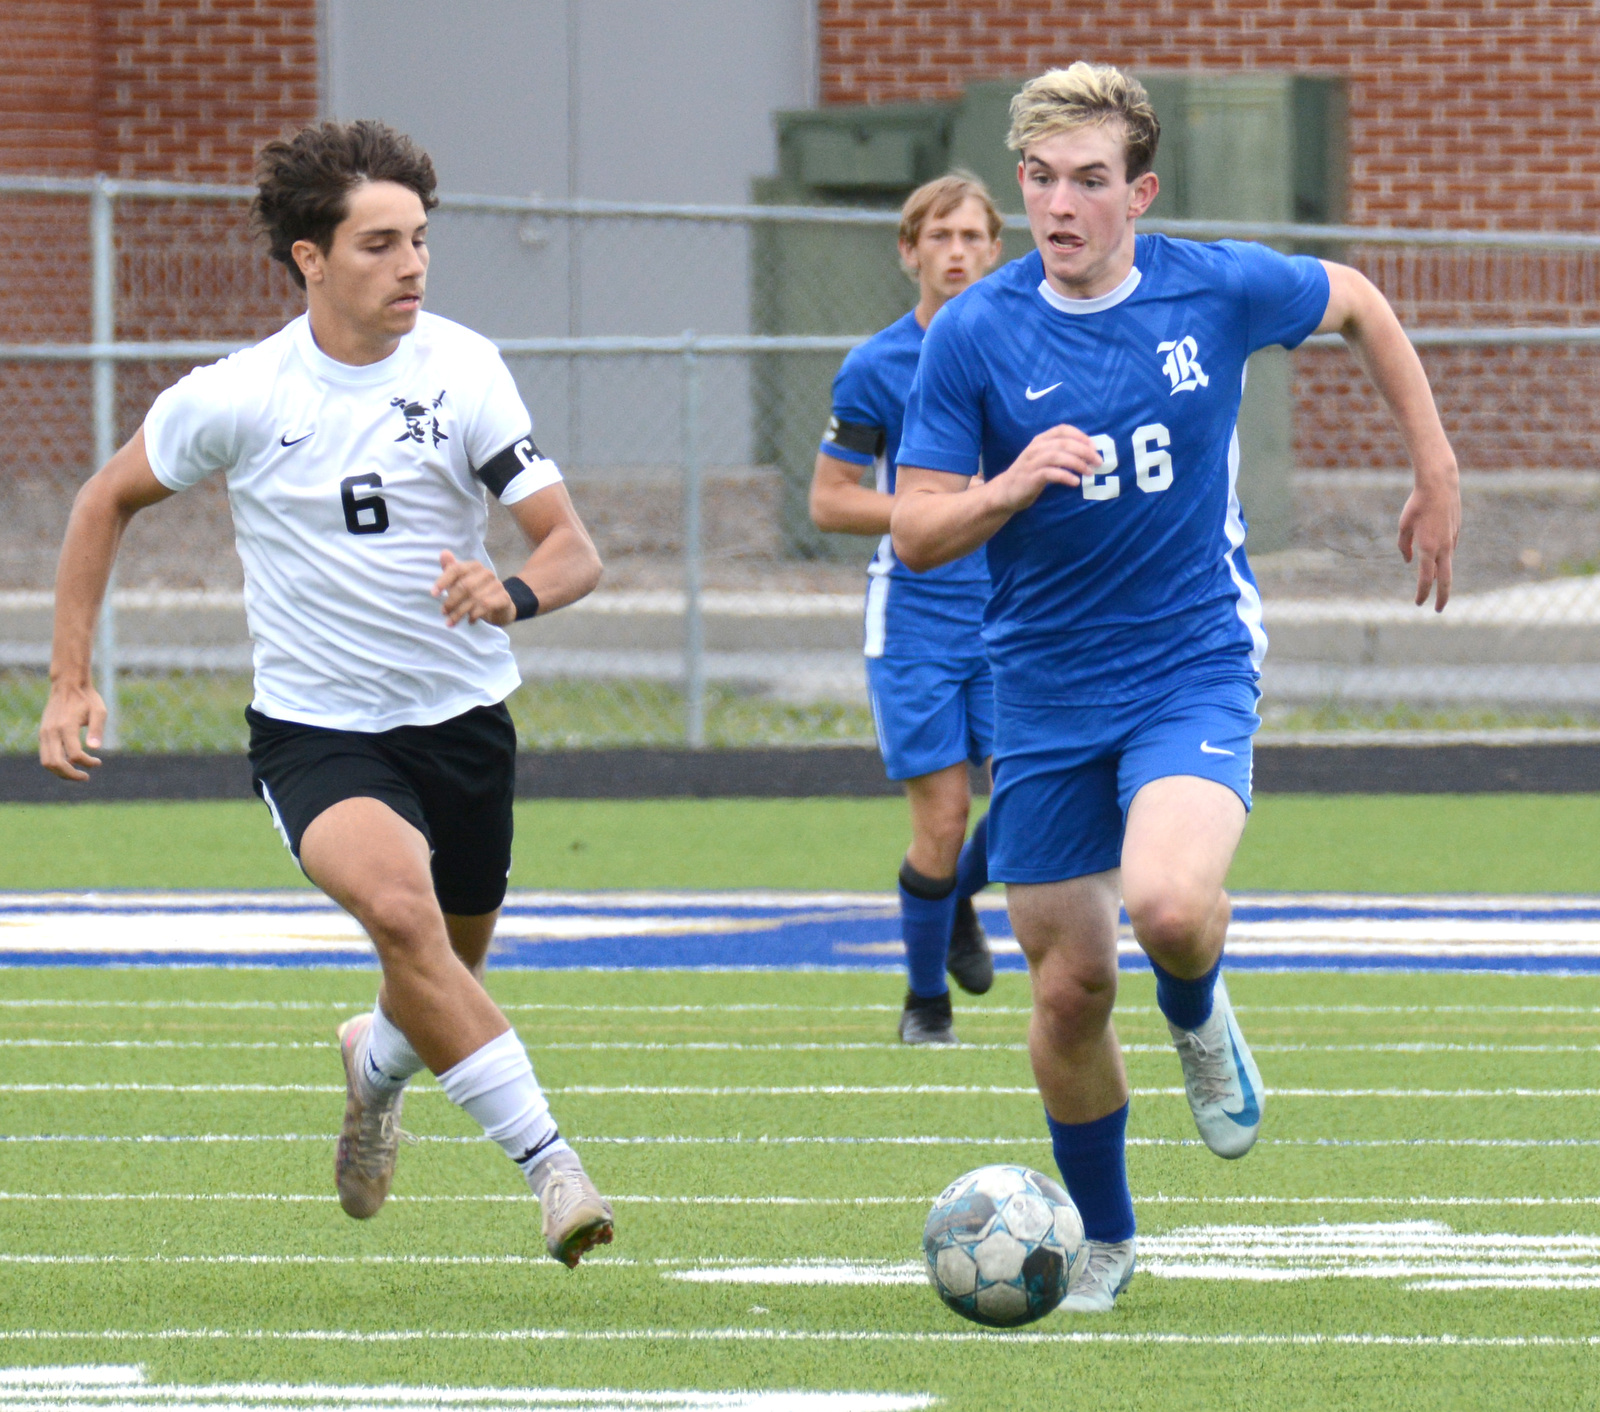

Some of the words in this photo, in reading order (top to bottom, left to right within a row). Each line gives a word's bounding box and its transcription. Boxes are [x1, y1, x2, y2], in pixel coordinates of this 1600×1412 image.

[1156, 335, 1209, 396] R
[514, 439, 542, 471] C
[1081, 423, 1174, 500] 26
[340, 472, 389, 535] 6
